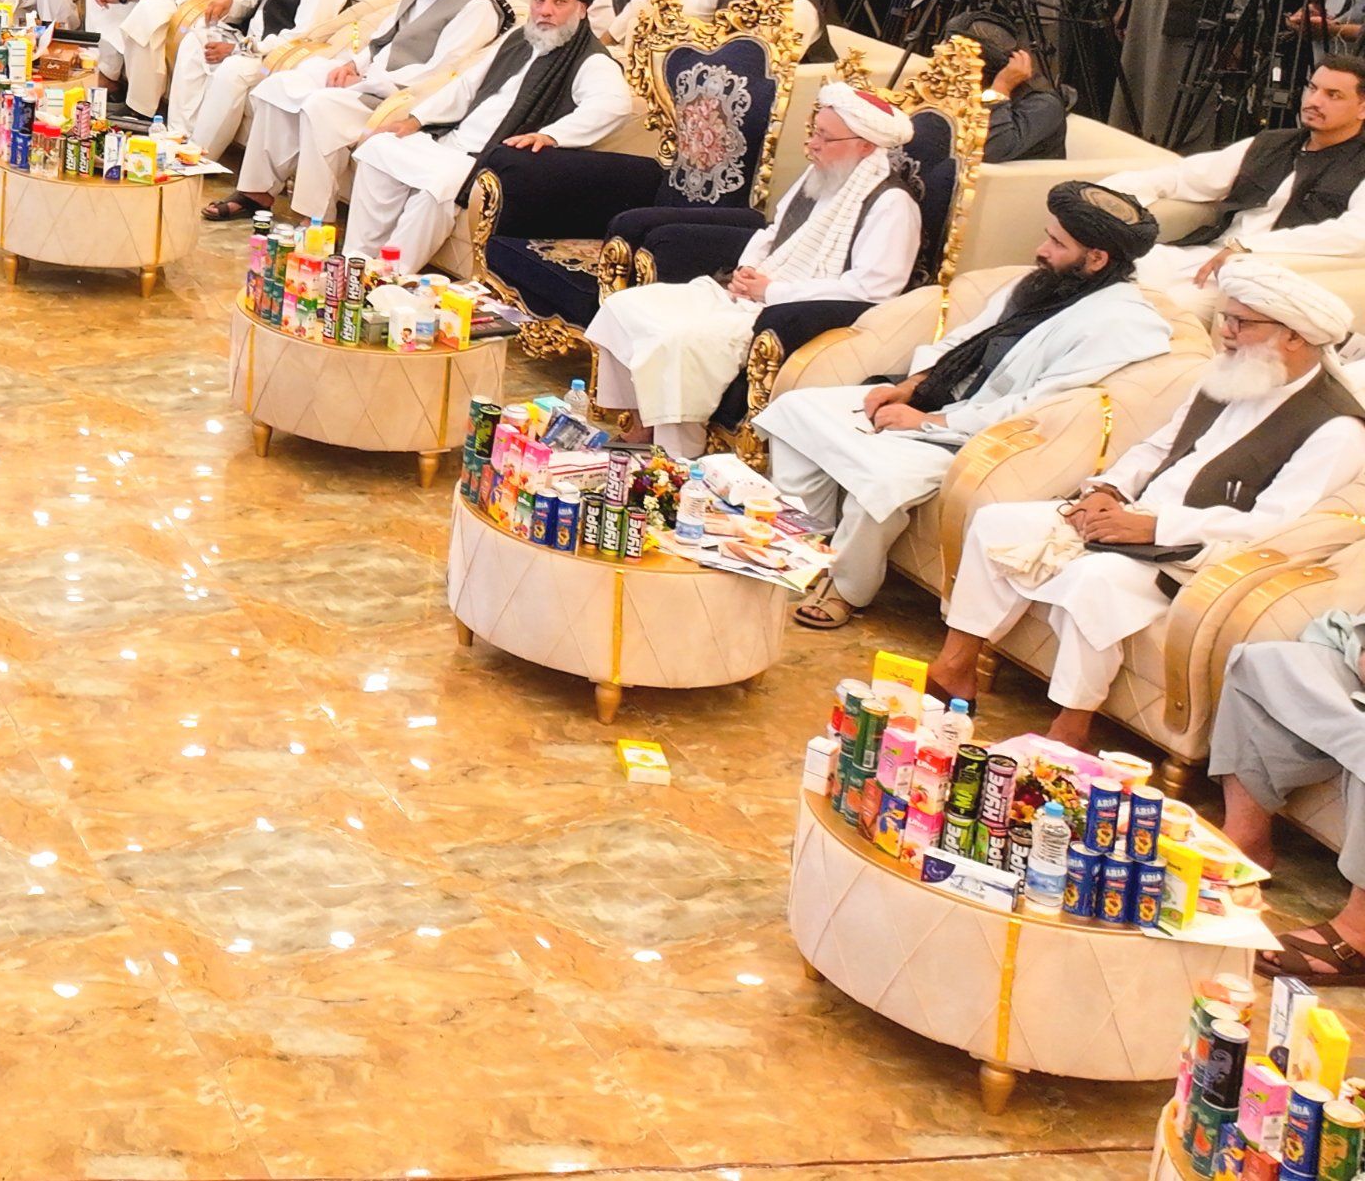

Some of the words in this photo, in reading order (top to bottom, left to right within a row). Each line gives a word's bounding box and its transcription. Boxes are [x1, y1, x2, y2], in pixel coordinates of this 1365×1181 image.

[606, 462, 620, 501] HYPE
[584, 505, 599, 545] HYPE
[602, 509, 619, 550] HYPE
[626, 518, 642, 557] HYPE
[982, 772, 1005, 822] HYPE
[1096, 798, 1118, 808] ARIA
[1134, 806, 1158, 816] ARIA
[1105, 868, 1127, 878] ARIA
[1140, 873, 1162, 883] ARIA
